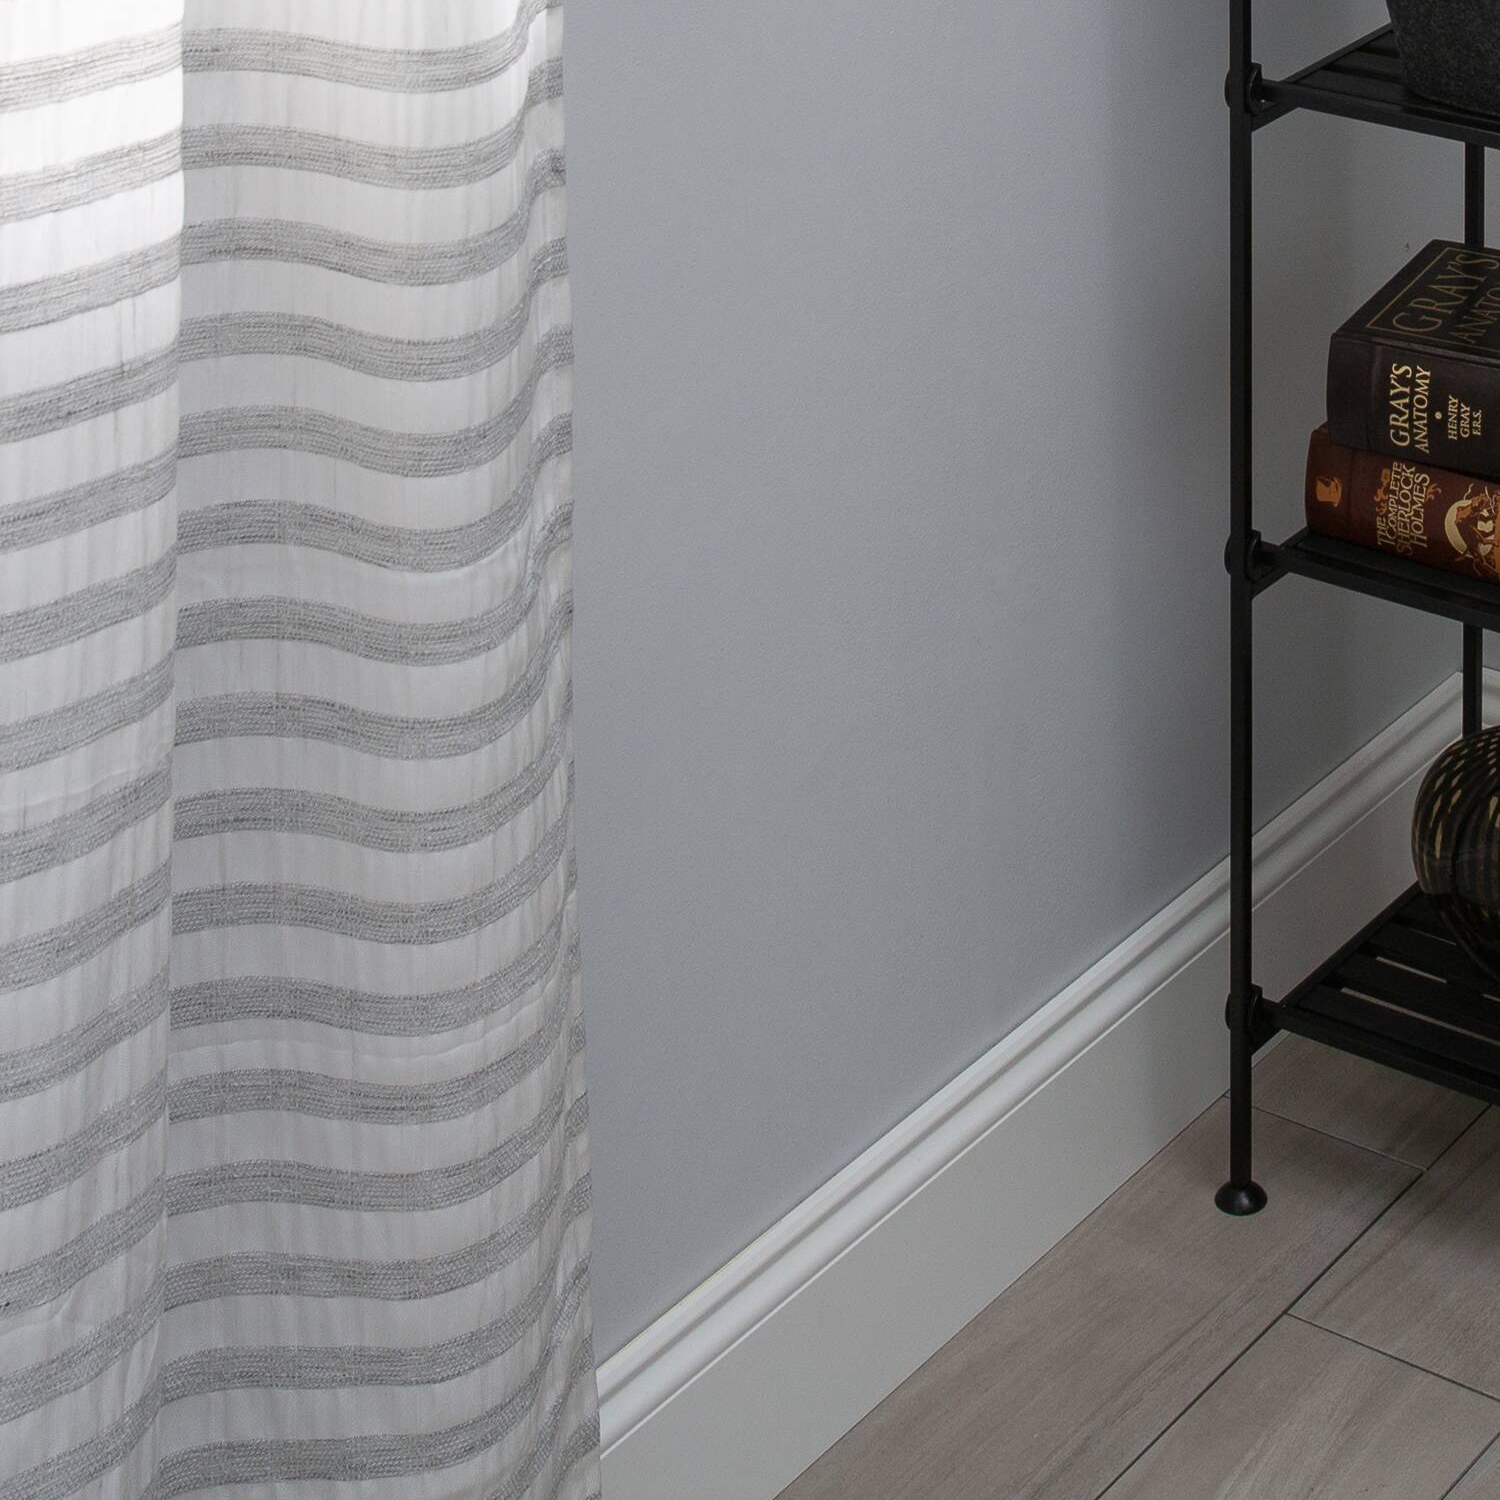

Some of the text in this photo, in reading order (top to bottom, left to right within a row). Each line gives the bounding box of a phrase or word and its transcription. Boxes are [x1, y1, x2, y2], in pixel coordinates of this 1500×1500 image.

[1392, 253, 1500, 332] GRAY'S
[1389, 363, 1412, 447] GRAY'S
[1412, 365, 1432, 454] ANATOMY
[1447, 394, 1459, 441] HENRY
[1459, 402, 1471, 438] GRAY
[1376, 516, 1396, 547] THE
[1386, 461, 1404, 540] COMPLETE
[1396, 461, 1415, 557] SHERLOCK
[1410, 472, 1430, 548] HOLMES
